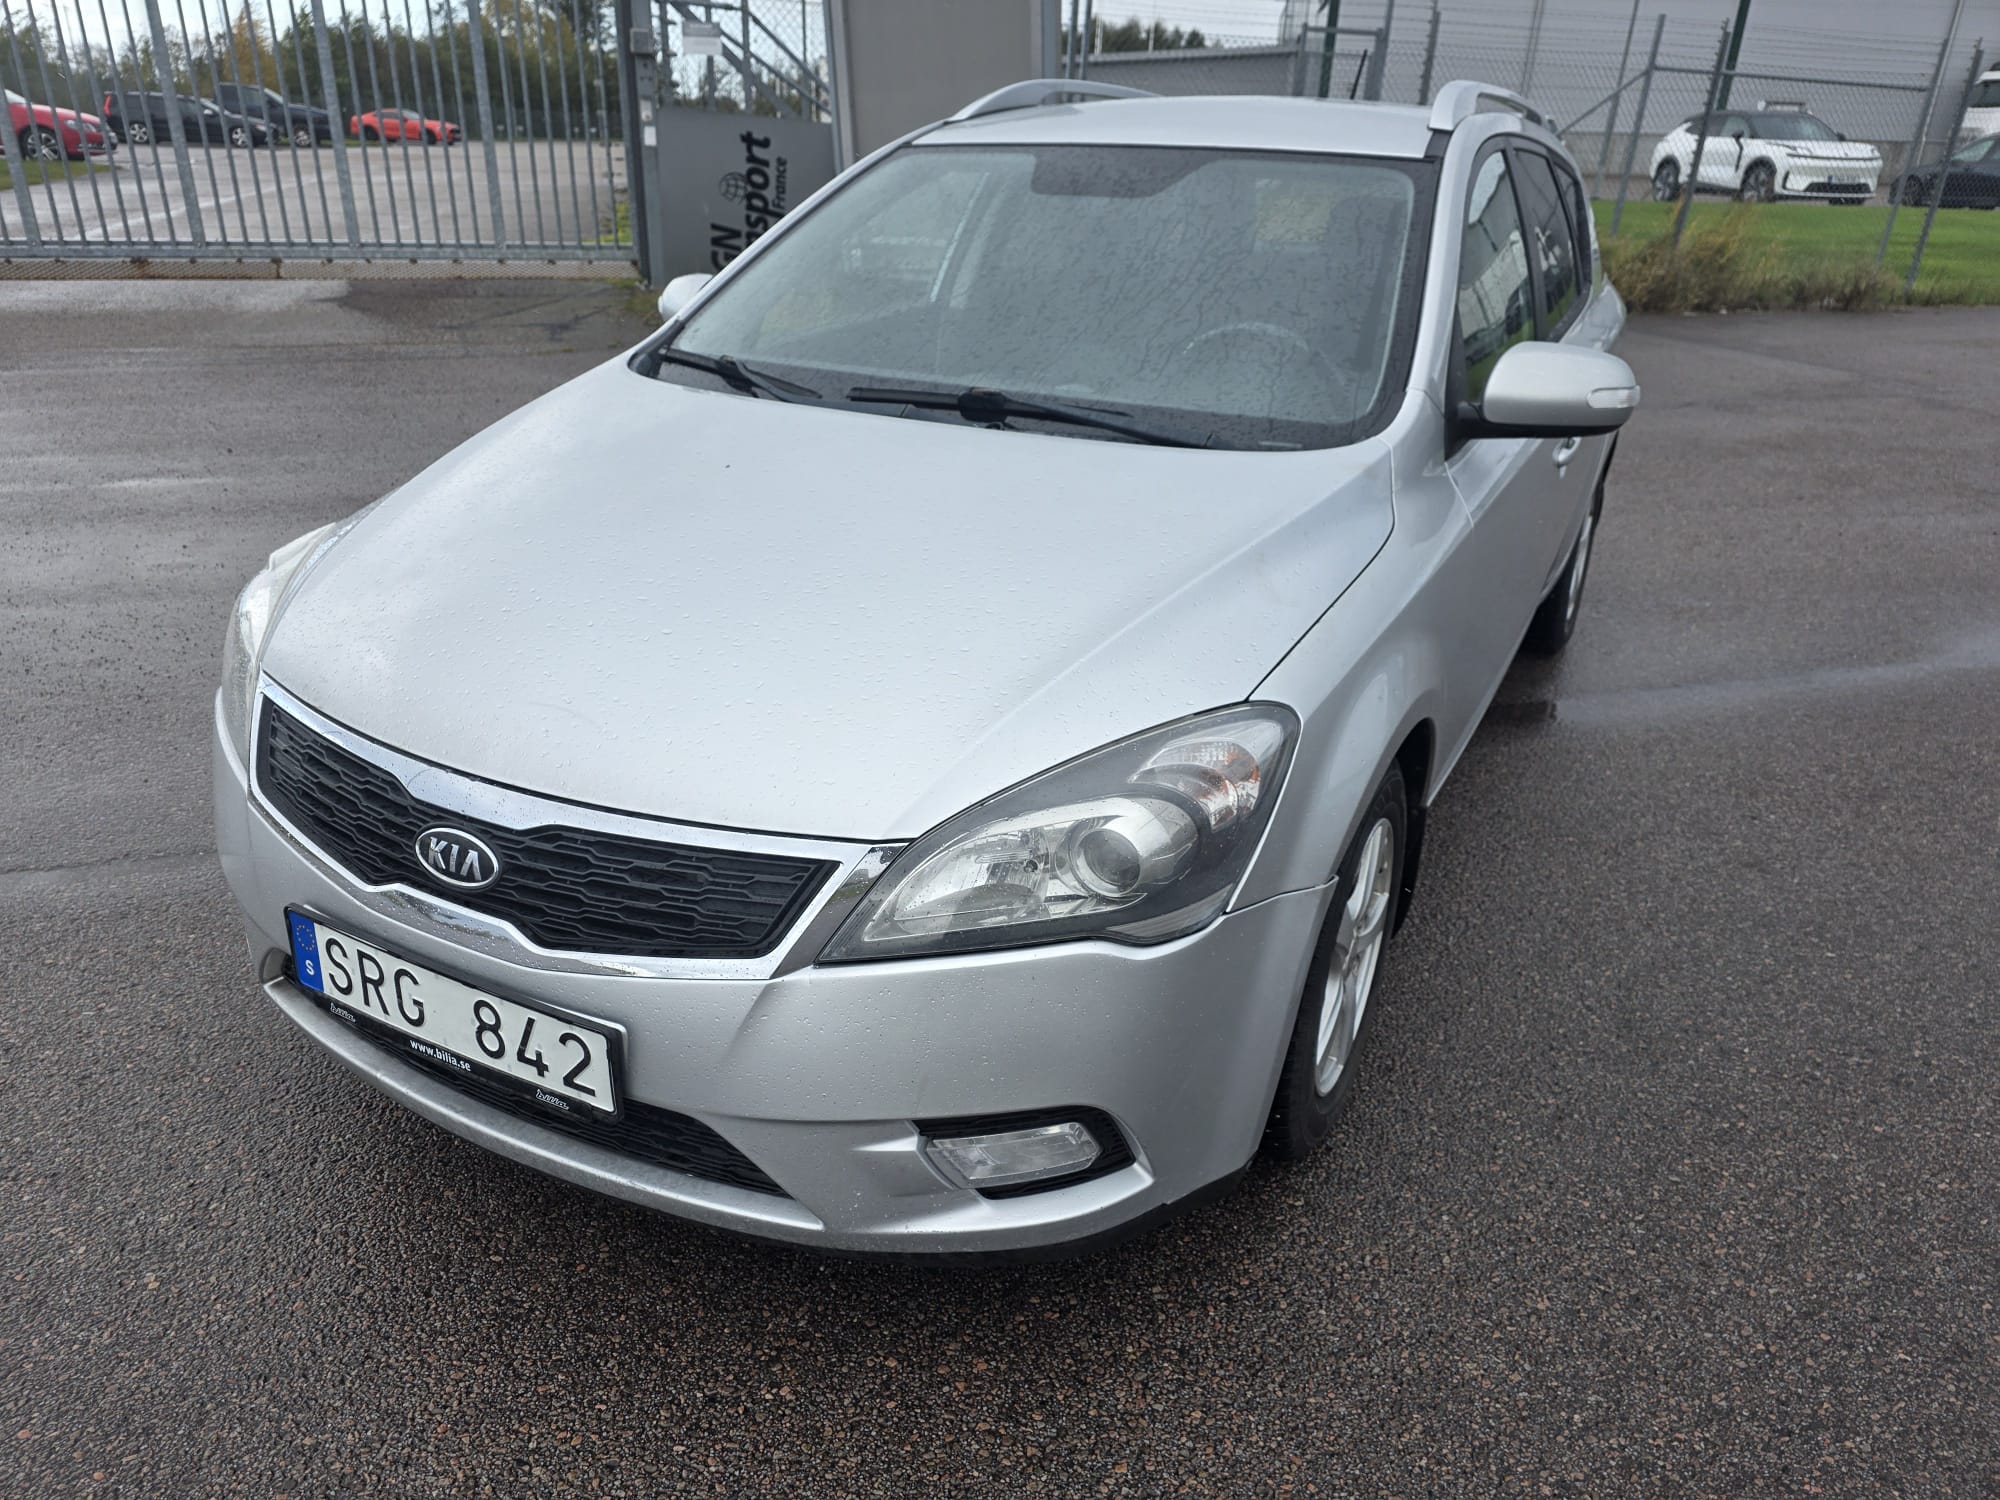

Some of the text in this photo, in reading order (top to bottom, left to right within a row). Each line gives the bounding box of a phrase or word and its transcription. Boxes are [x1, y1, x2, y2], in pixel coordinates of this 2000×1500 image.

[772, 157, 787, 209] France
[427, 836, 482, 881] KIA
[305, 960, 315, 975] S
[325, 937, 596, 1097] SRG 842
[410, 1039, 471, 1072] www.bilia.se
